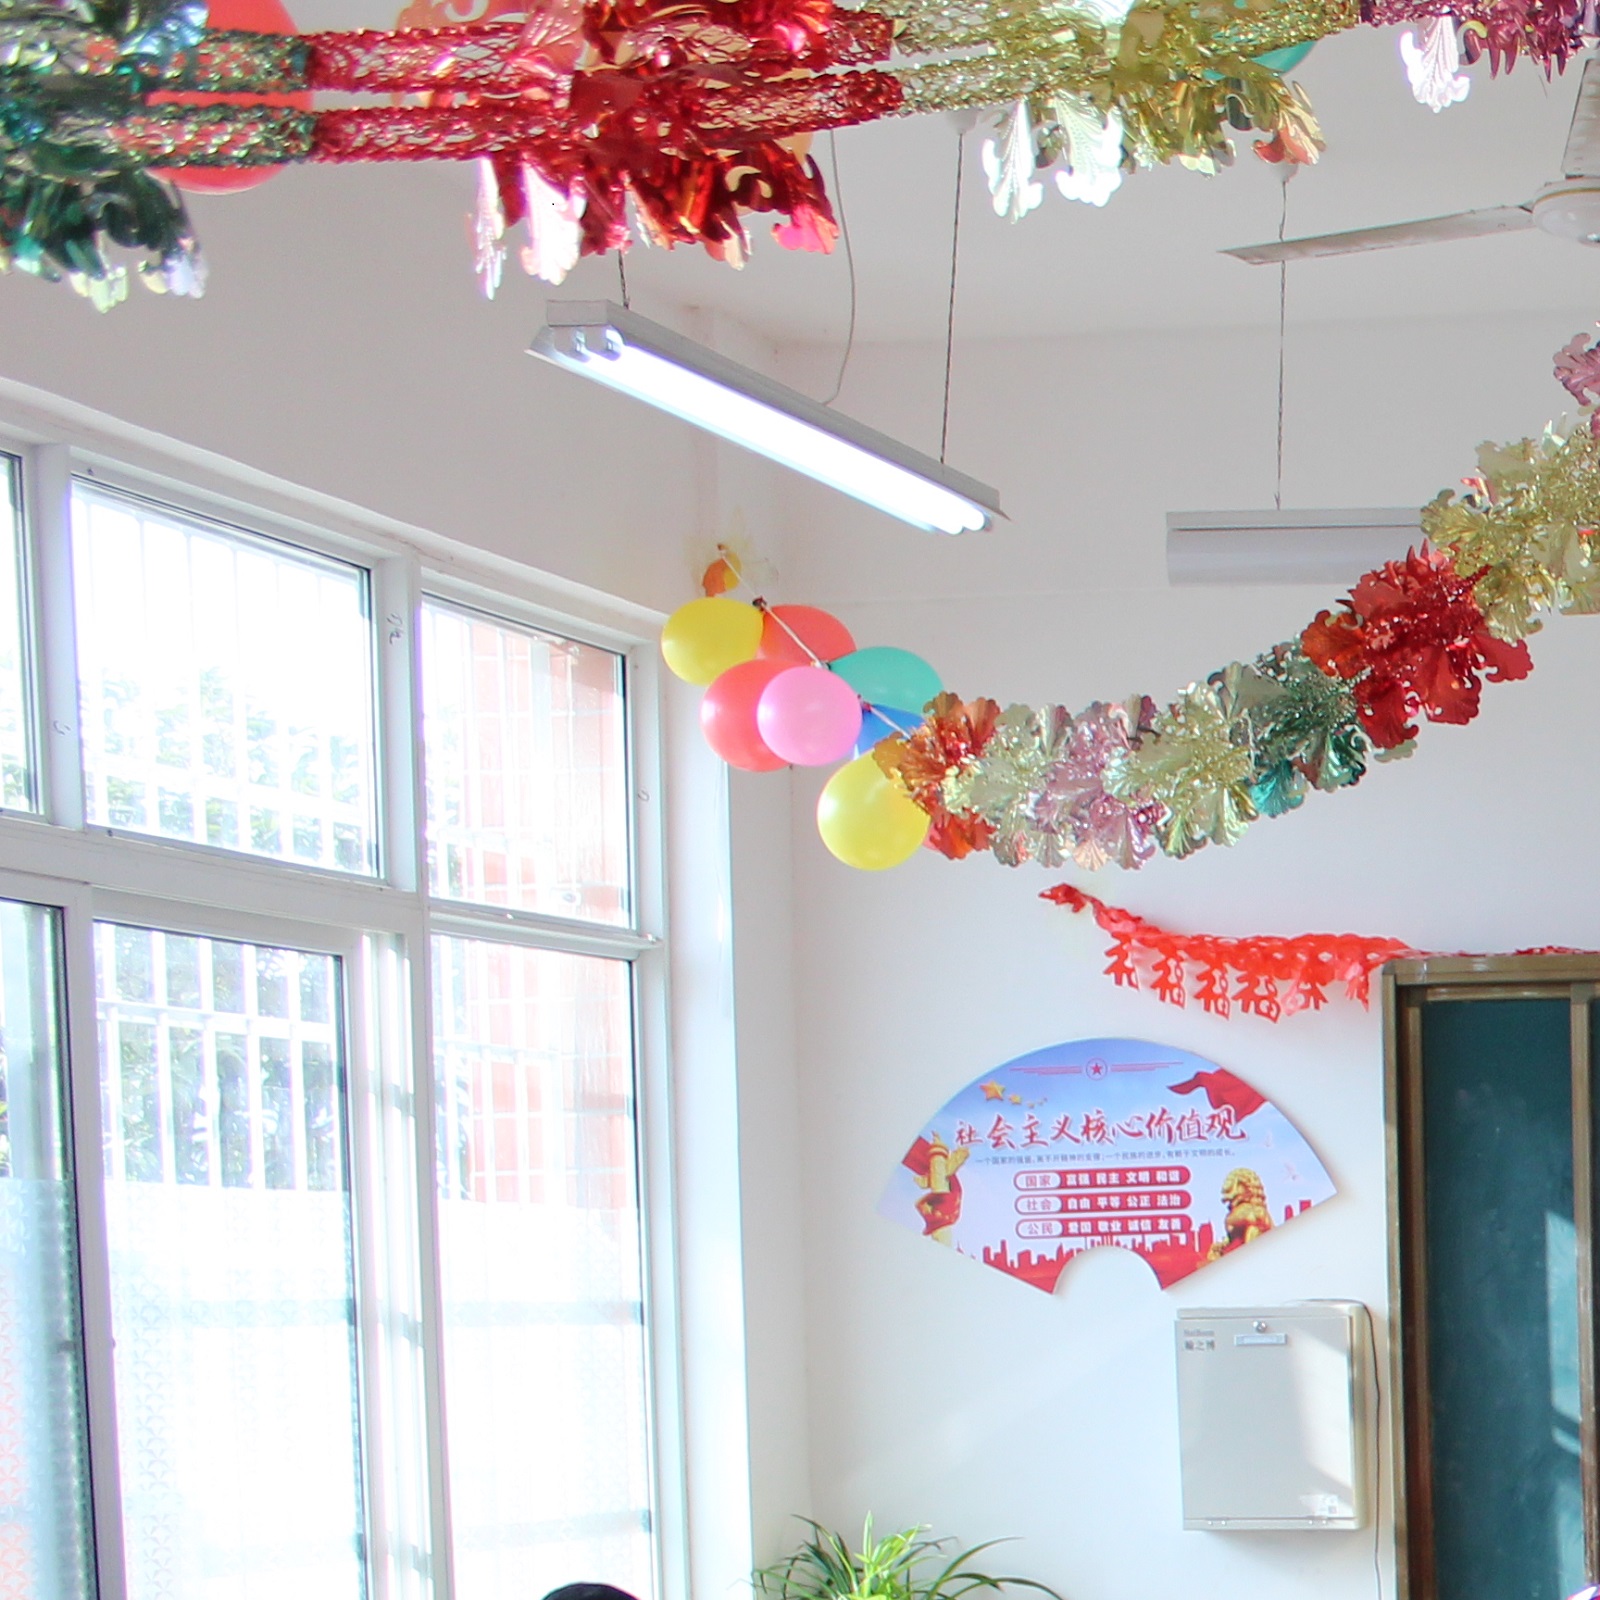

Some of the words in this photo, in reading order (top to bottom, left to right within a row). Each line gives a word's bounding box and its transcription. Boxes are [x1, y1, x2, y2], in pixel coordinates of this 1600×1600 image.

[955, 1106, 1247, 1150] 社会主义核心价值观
[1025, 1173, 1052, 1188] 国家
[1096, 1171, 1121, 1185] 民主
[1126, 1170, 1150, 1184] 文明
[1026, 1197, 1052, 1211] 社会
[1067, 1197, 1091, 1210] 自由
[1097, 1196, 1121, 1209] 平等
[1127, 1195, 1151, 1208] 公正
[1156, 1194, 1181, 1207] 法治
[1027, 1221, 1054, 1235] 公民
